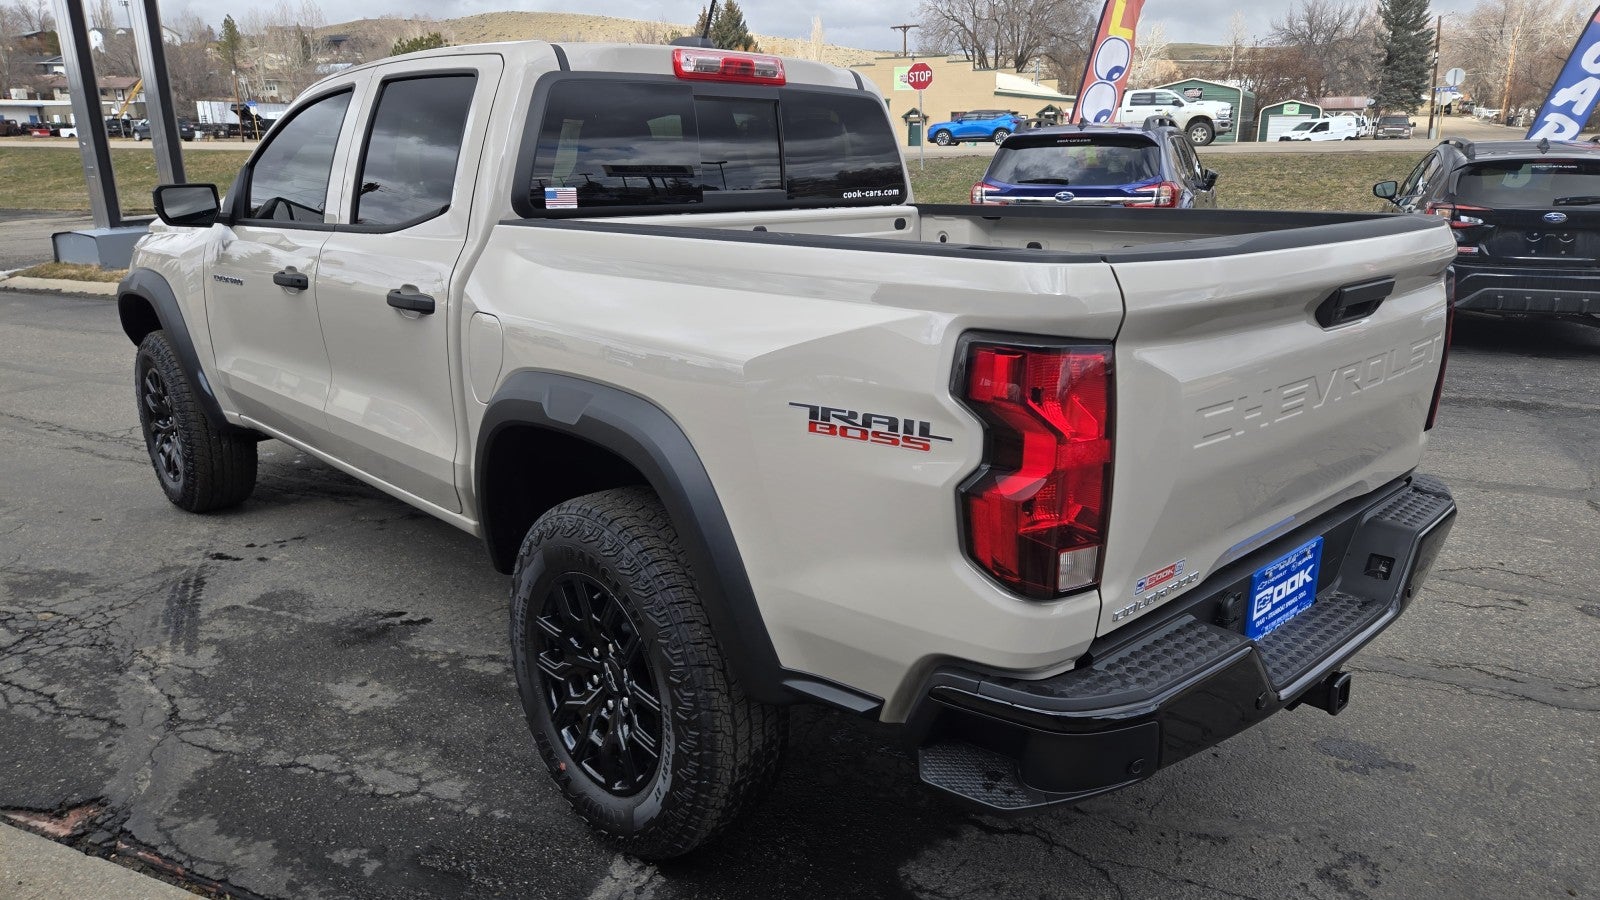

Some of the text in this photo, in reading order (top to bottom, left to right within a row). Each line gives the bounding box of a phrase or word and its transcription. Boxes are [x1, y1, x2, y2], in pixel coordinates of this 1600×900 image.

[908, 70, 932, 83] STOP
[842, 189, 900, 199] cook-cars.com
[1193, 332, 1442, 449] CHEVROLET
[788, 401, 953, 442] TRAIL
[808, 420, 931, 452] BOSS
[1112, 571, 1200, 622] COLORADO
[1252, 563, 1315, 622] COOK
